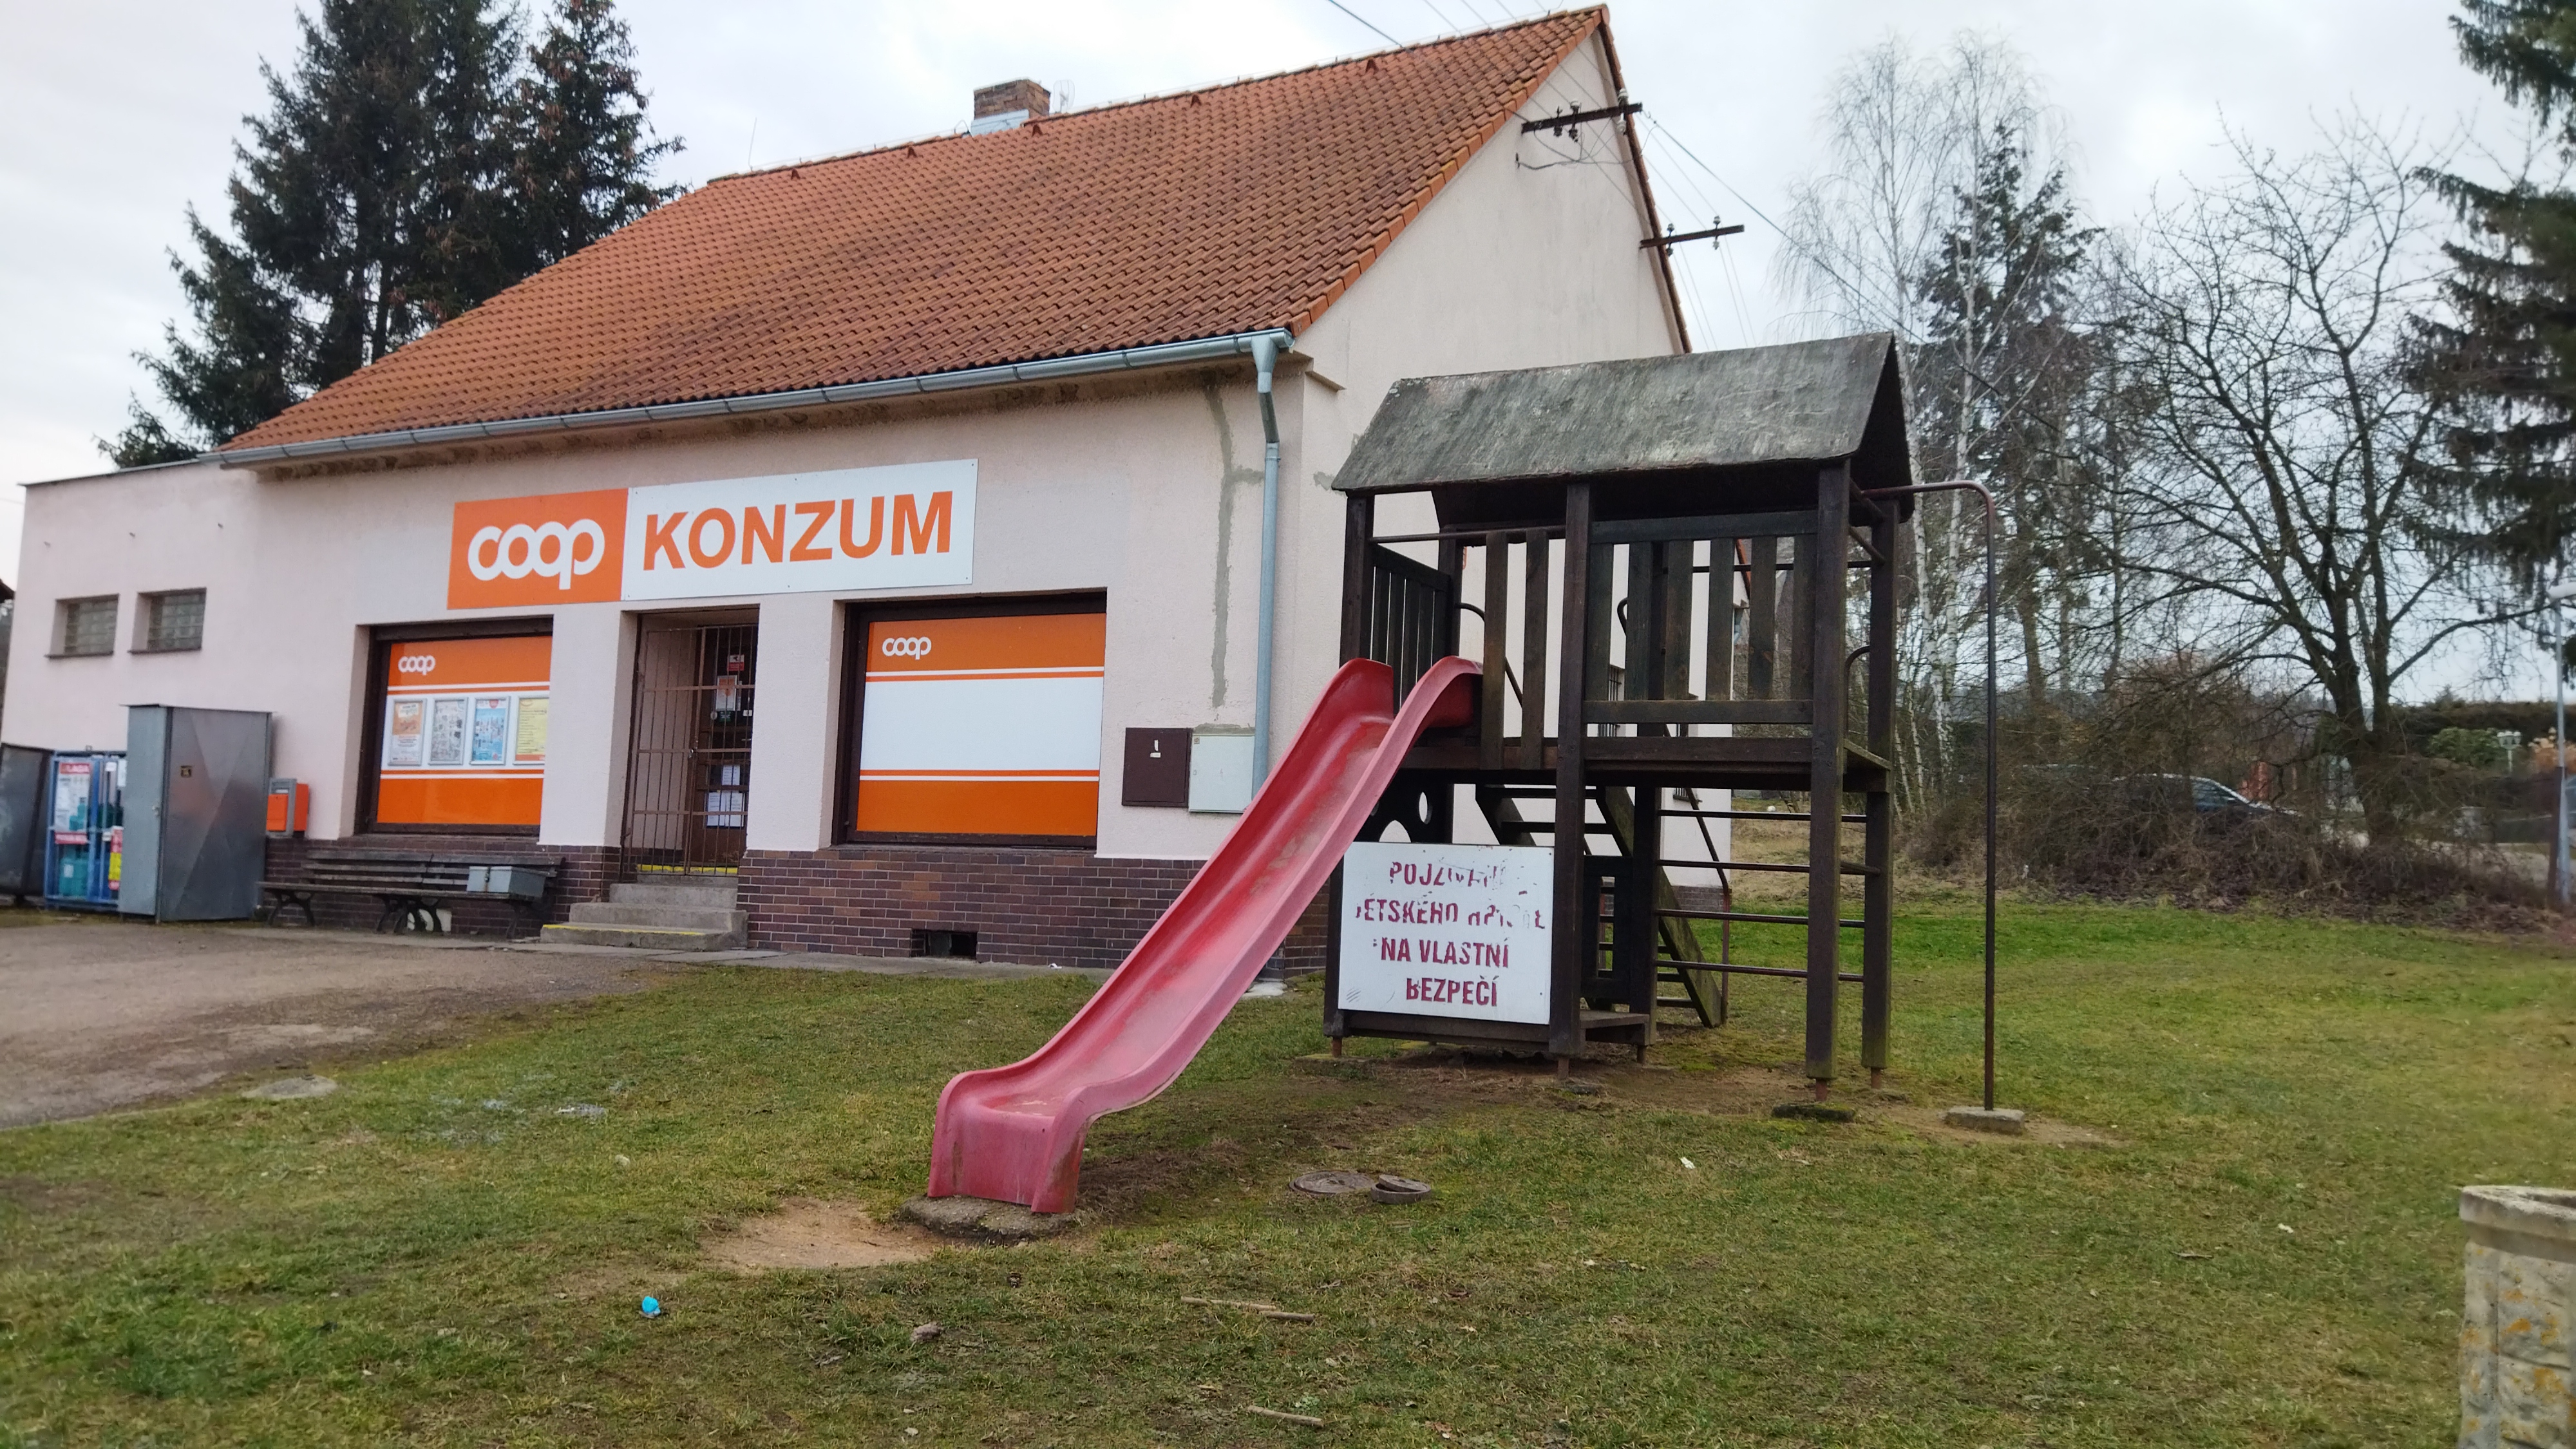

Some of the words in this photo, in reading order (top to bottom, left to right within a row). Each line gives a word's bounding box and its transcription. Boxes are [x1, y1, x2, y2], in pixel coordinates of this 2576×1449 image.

[468, 518, 605, 590] coop
[643, 491, 954, 571] KONZUM
[882, 636, 933, 660] coop
[398, 655, 436, 676] coop
[1381, 938, 1411, 962] NA
[1419, 937, 1509, 968] VLASTNÍ
[1406, 975, 1499, 1007] BEZPEČÍ
